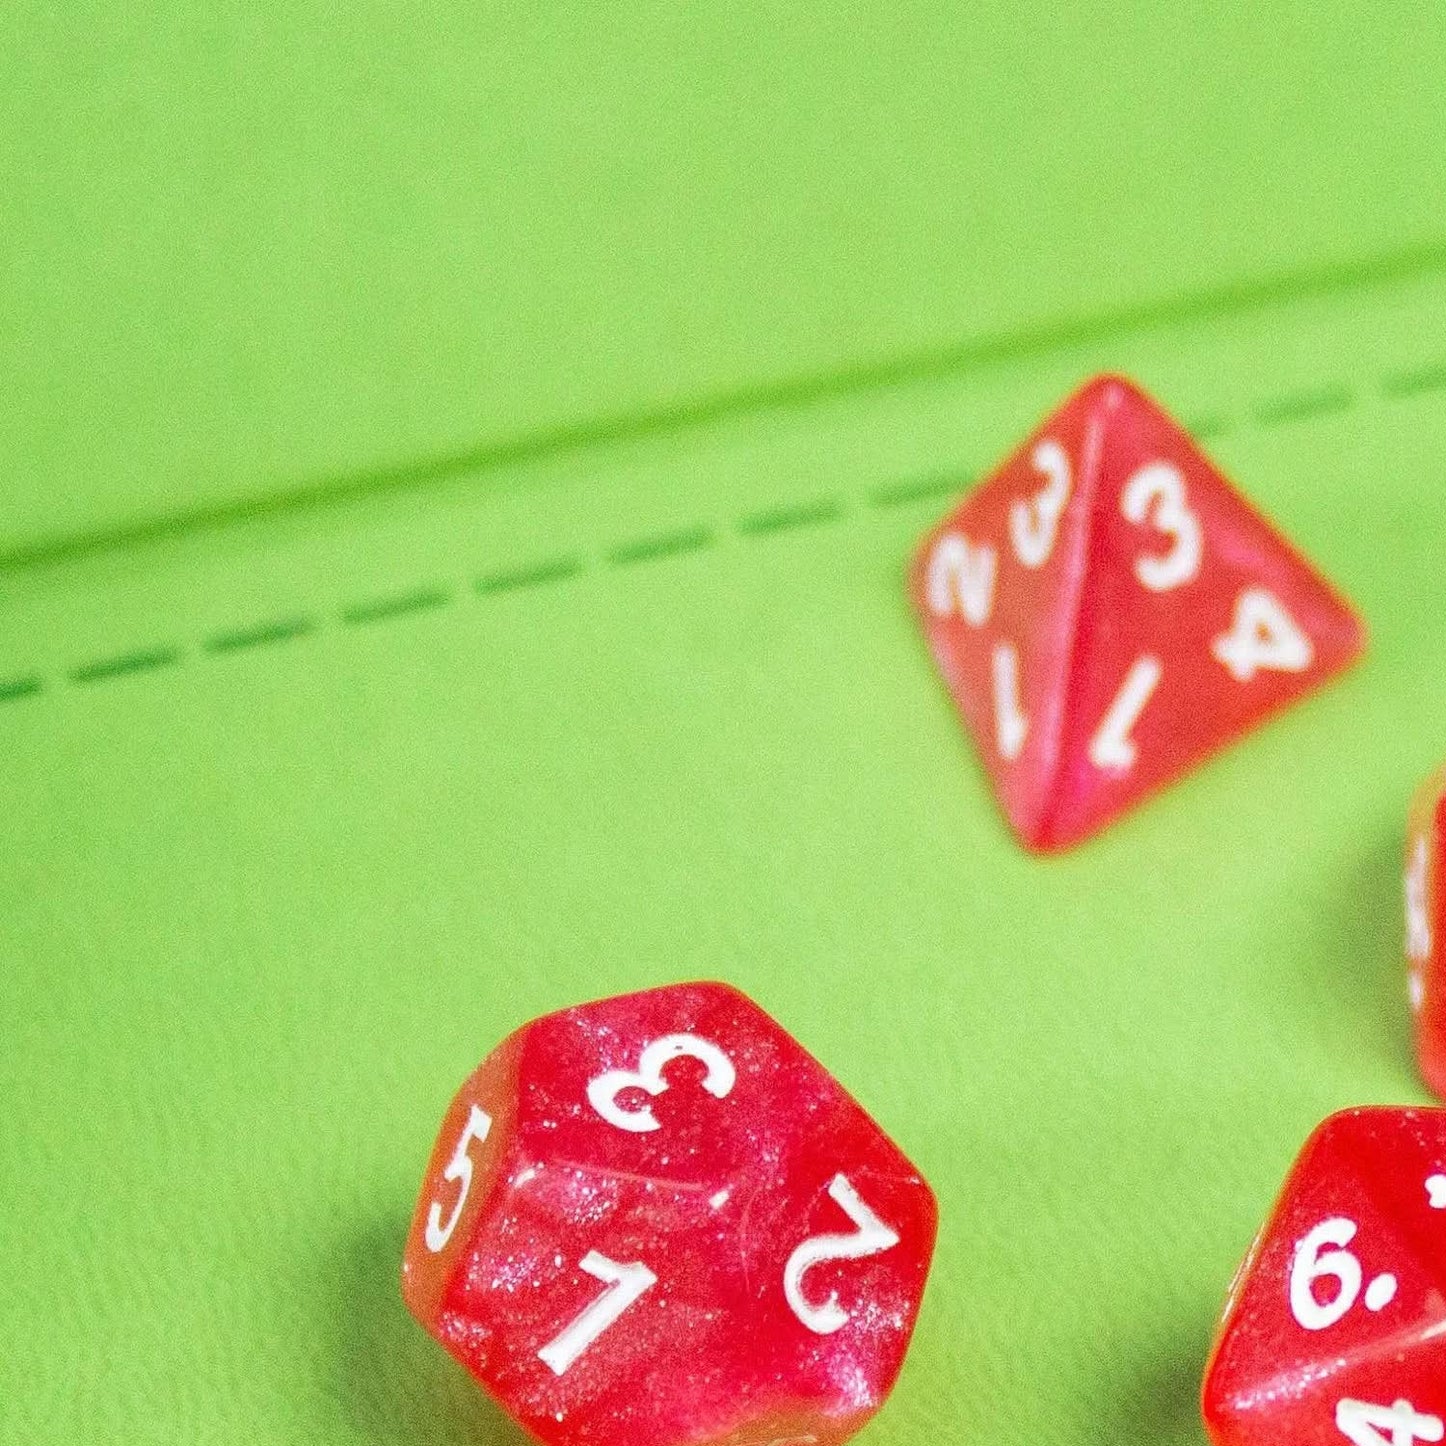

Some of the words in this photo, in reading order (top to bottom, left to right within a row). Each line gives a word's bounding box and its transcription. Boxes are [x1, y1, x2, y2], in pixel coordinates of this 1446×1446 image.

[925, 532, 999, 628] 2
[1120, 460, 1205, 592] 3
[1210, 585, 1315, 683] 4
[992, 642, 1028, 760] 1
[1091, 654, 1163, 769] 1
[586, 1032, 737, 1133] 3
[424, 1104, 493, 1253] 5
[536, 1249, 658, 1376] 1
[783, 1173, 900, 1334] 2
